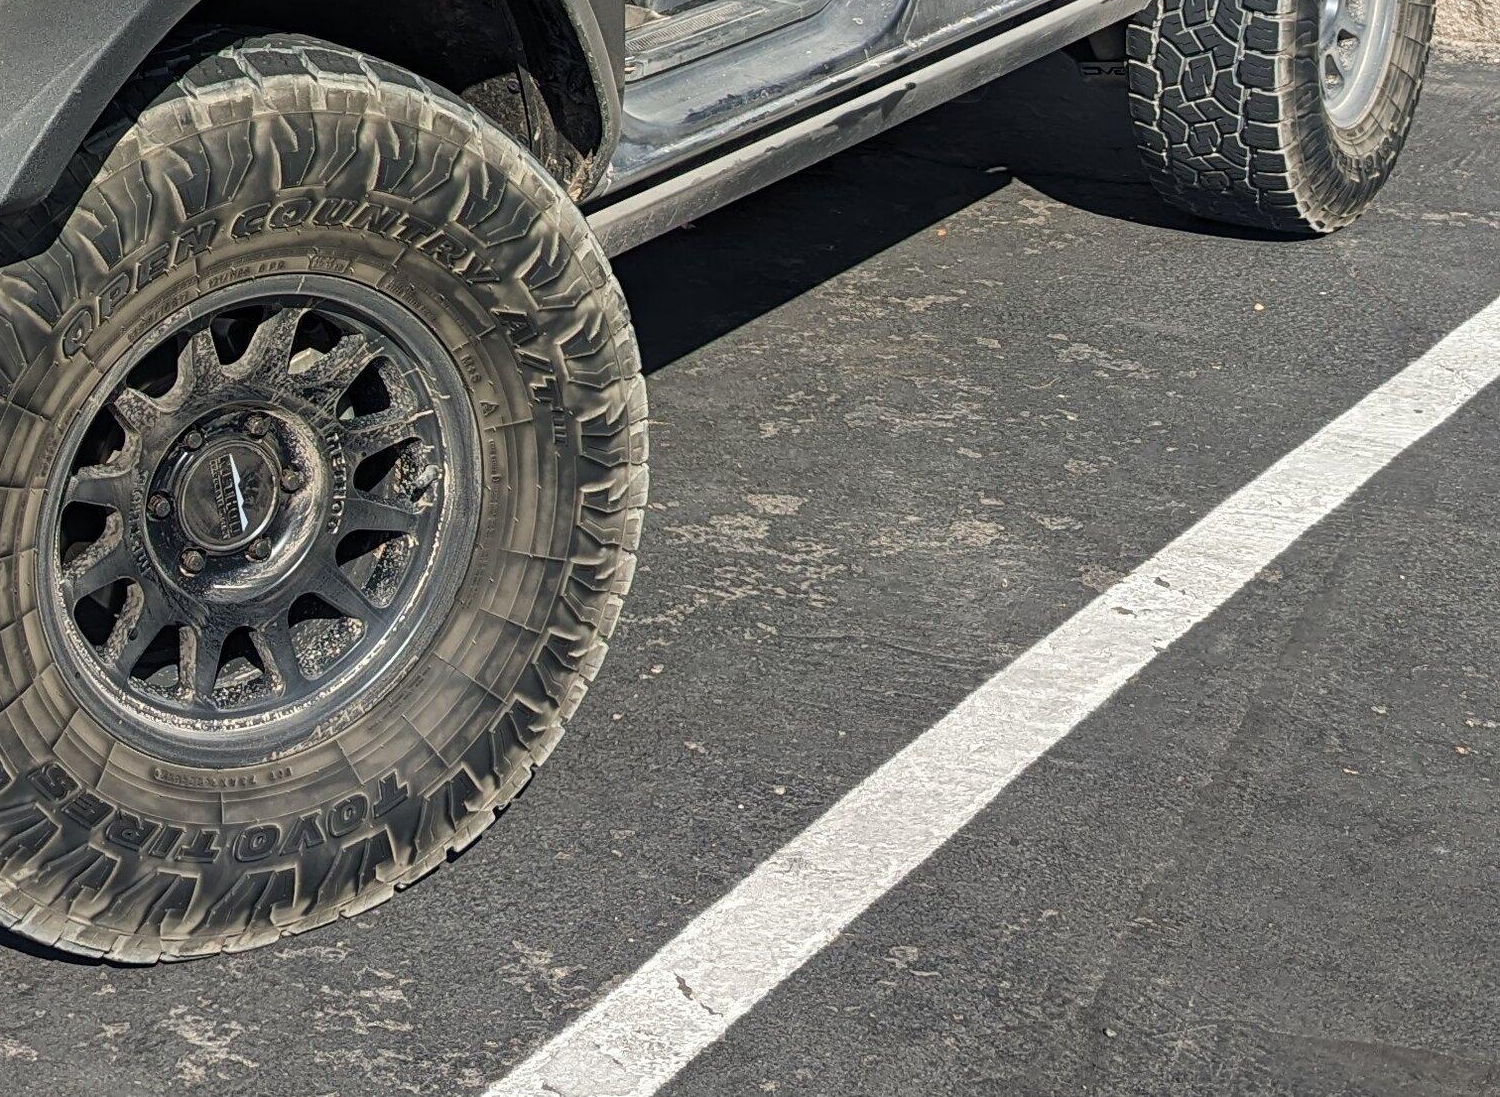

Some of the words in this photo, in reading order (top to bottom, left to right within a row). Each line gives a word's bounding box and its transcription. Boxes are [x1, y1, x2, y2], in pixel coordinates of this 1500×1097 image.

[62, 219, 218, 360] OPEN
[230, 196, 502, 286] COUNTRY
[324, 433, 348, 535] METHOD
[28, 761, 221, 864] TIRES
[232, 769, 411, 863] TOYO
